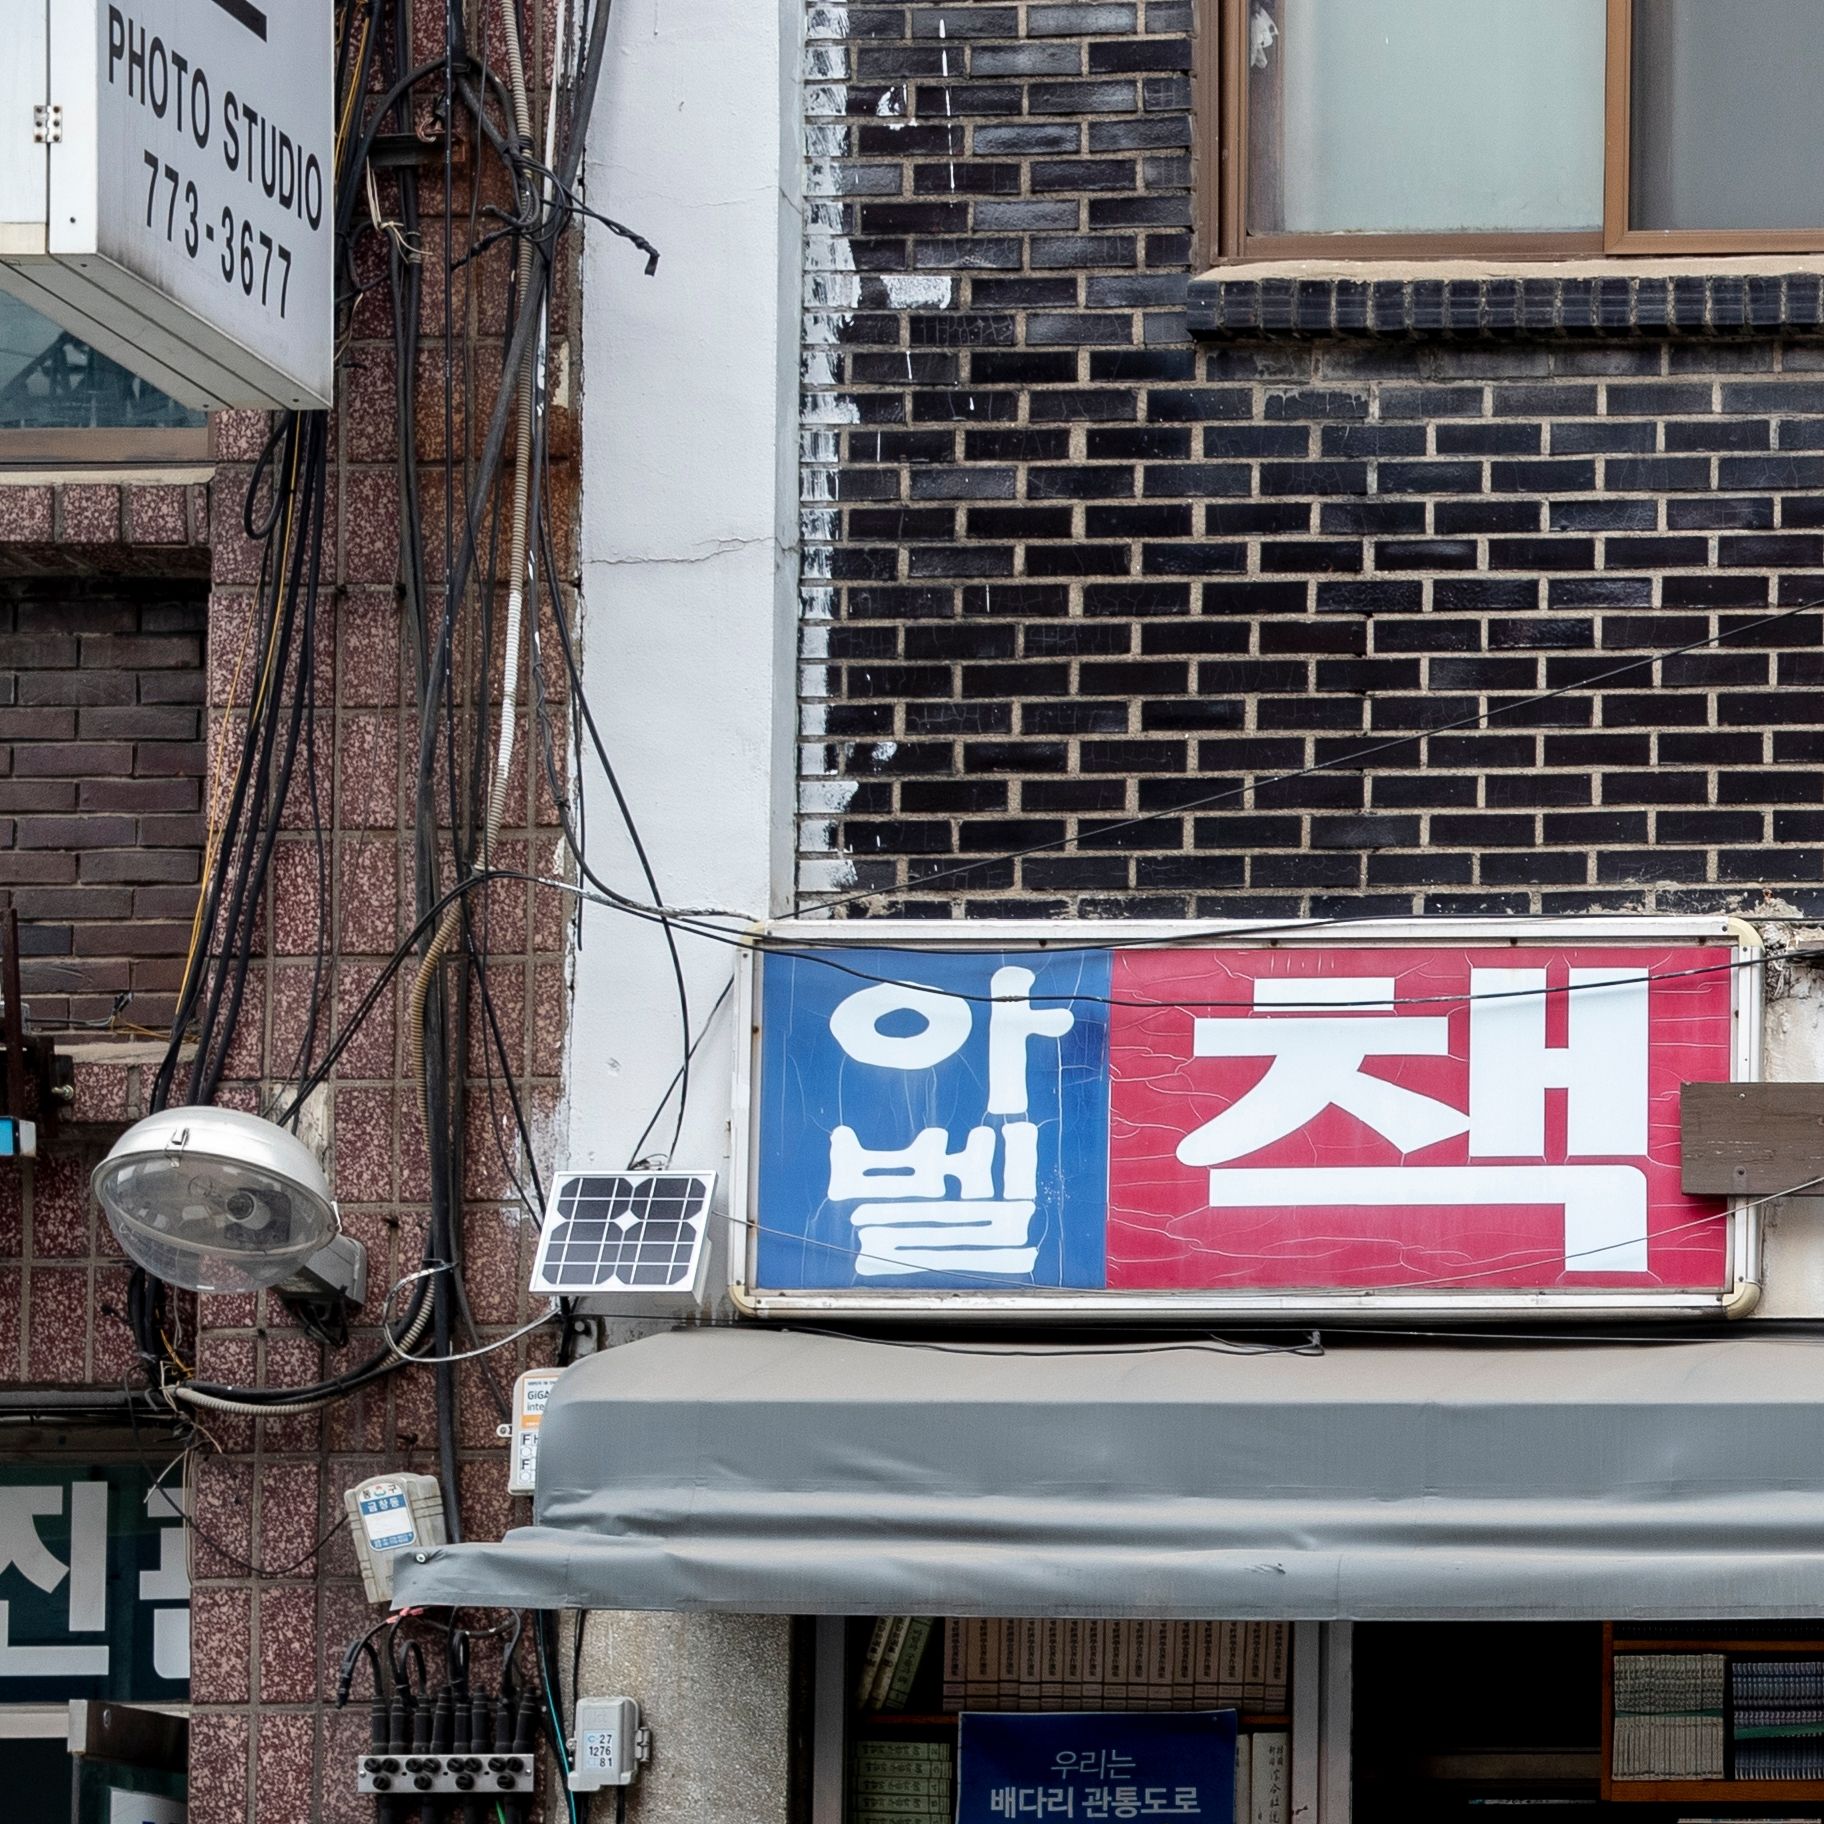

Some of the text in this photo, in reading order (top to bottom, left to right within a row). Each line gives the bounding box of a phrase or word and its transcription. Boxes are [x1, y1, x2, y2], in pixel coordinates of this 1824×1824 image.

[107, 15, 323, 231] PHOTO STUDIO
[143, 150, 292, 319] 773-3677
[827, 966, 1074, 1277] 아벨
[1175, 968, 1649, 1273] 책
[589, 1746, 612, 1756] 1276
[991, 1787, 1201, 1818] 배다리 관통도로
[1051, 1749, 1136, 1779] 우리는
